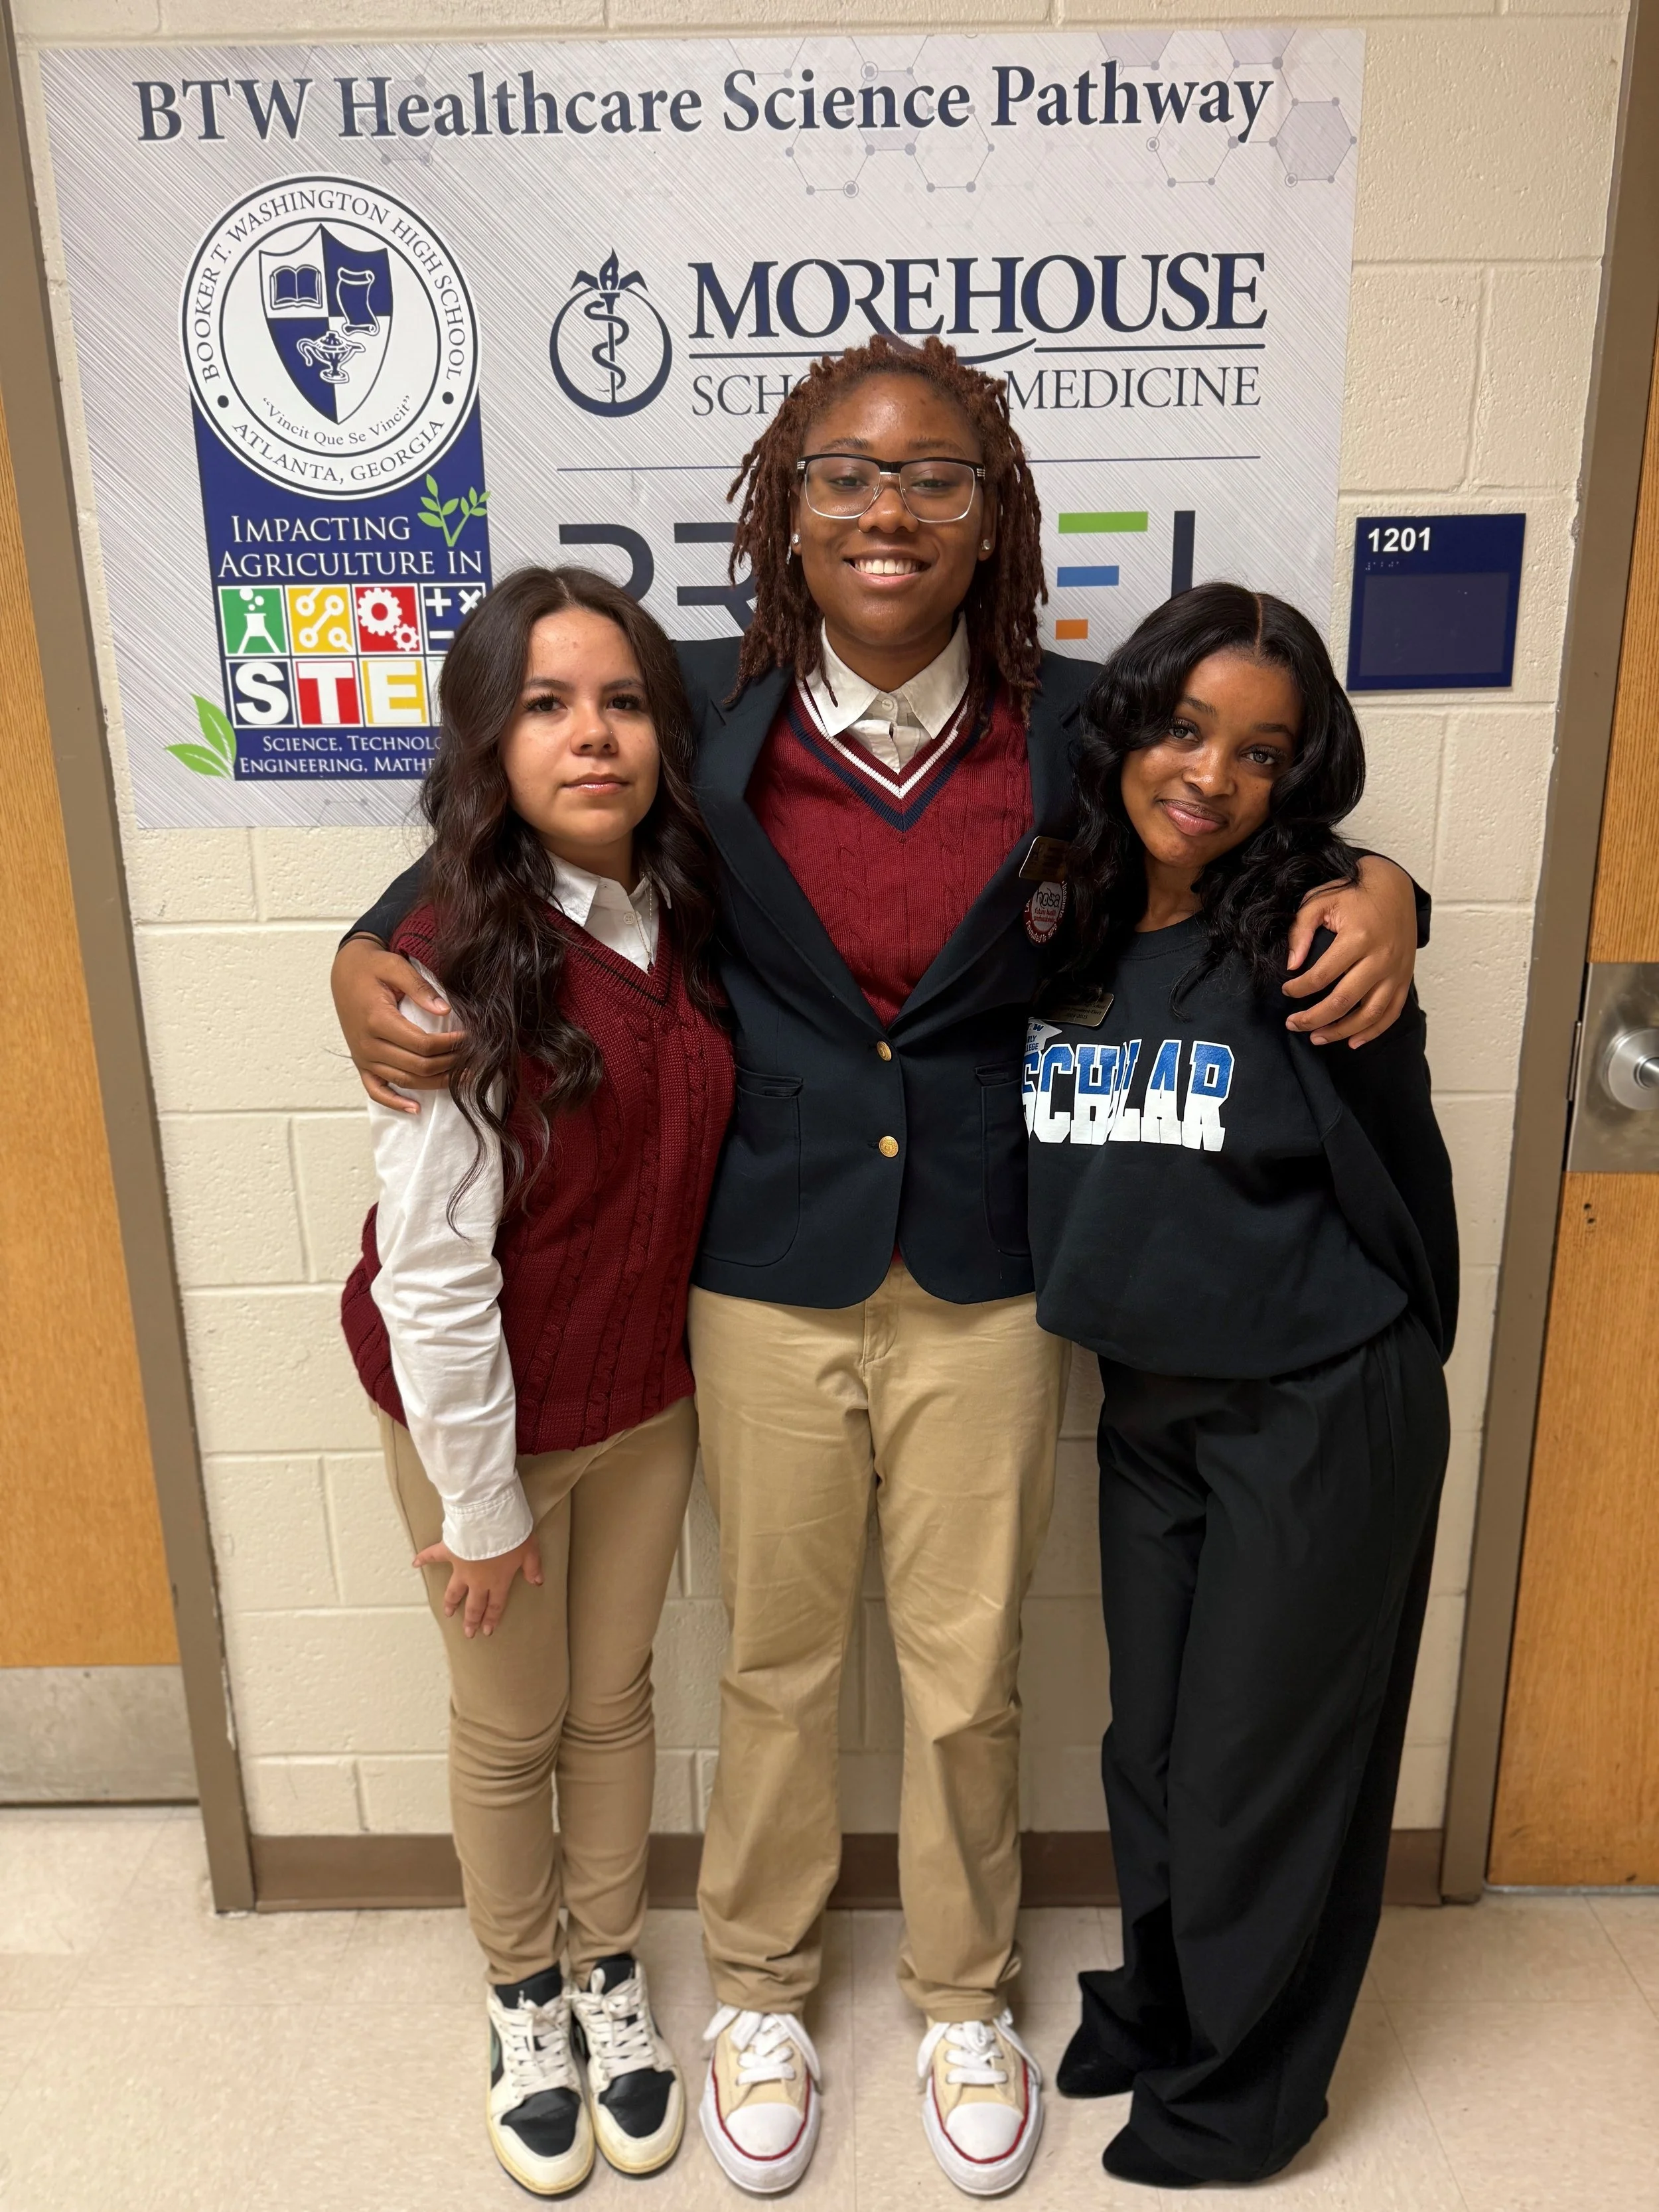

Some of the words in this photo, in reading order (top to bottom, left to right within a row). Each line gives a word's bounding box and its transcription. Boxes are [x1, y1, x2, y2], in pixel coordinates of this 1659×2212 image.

[133, 78, 315, 142] BTW
[335, 70, 703, 138] Healthcare
[723, 69, 970, 132] Science
[991, 60, 1273, 143] Pathway
[194, 267, 220, 383] BOOKER
[210, 243, 233, 265] T.
[226, 190, 391, 244] WASHINGTON
[390, 218, 444, 275] HIGH
[435, 275, 466, 381] SCHOOL
[688, 252, 1267, 364] MOREHOUSE
[691, 374, 811, 416] SCH
[1007, 366, 1261, 411] MEDICINE
[232, 421, 345, 485] ATLANTA,
[350, 419, 445, 481] GEORGIA
[314, 431, 344, 446] Que
[348, 432, 367, 445] Se
[231, 515, 410, 543] IMPACTING
[1368, 527, 1431, 552] 1201
[218, 551, 435, 577] AGRICULTURE
[447, 551, 482, 575] IN
[234, 661, 443, 727] STE
[240, 757, 368, 774] ENGINEERING,
[263, 736, 343, 753] SCIENCE,
[347, 735, 441, 751] TECHNOL
[1022, 1039, 1235, 1151] SCHLAR
